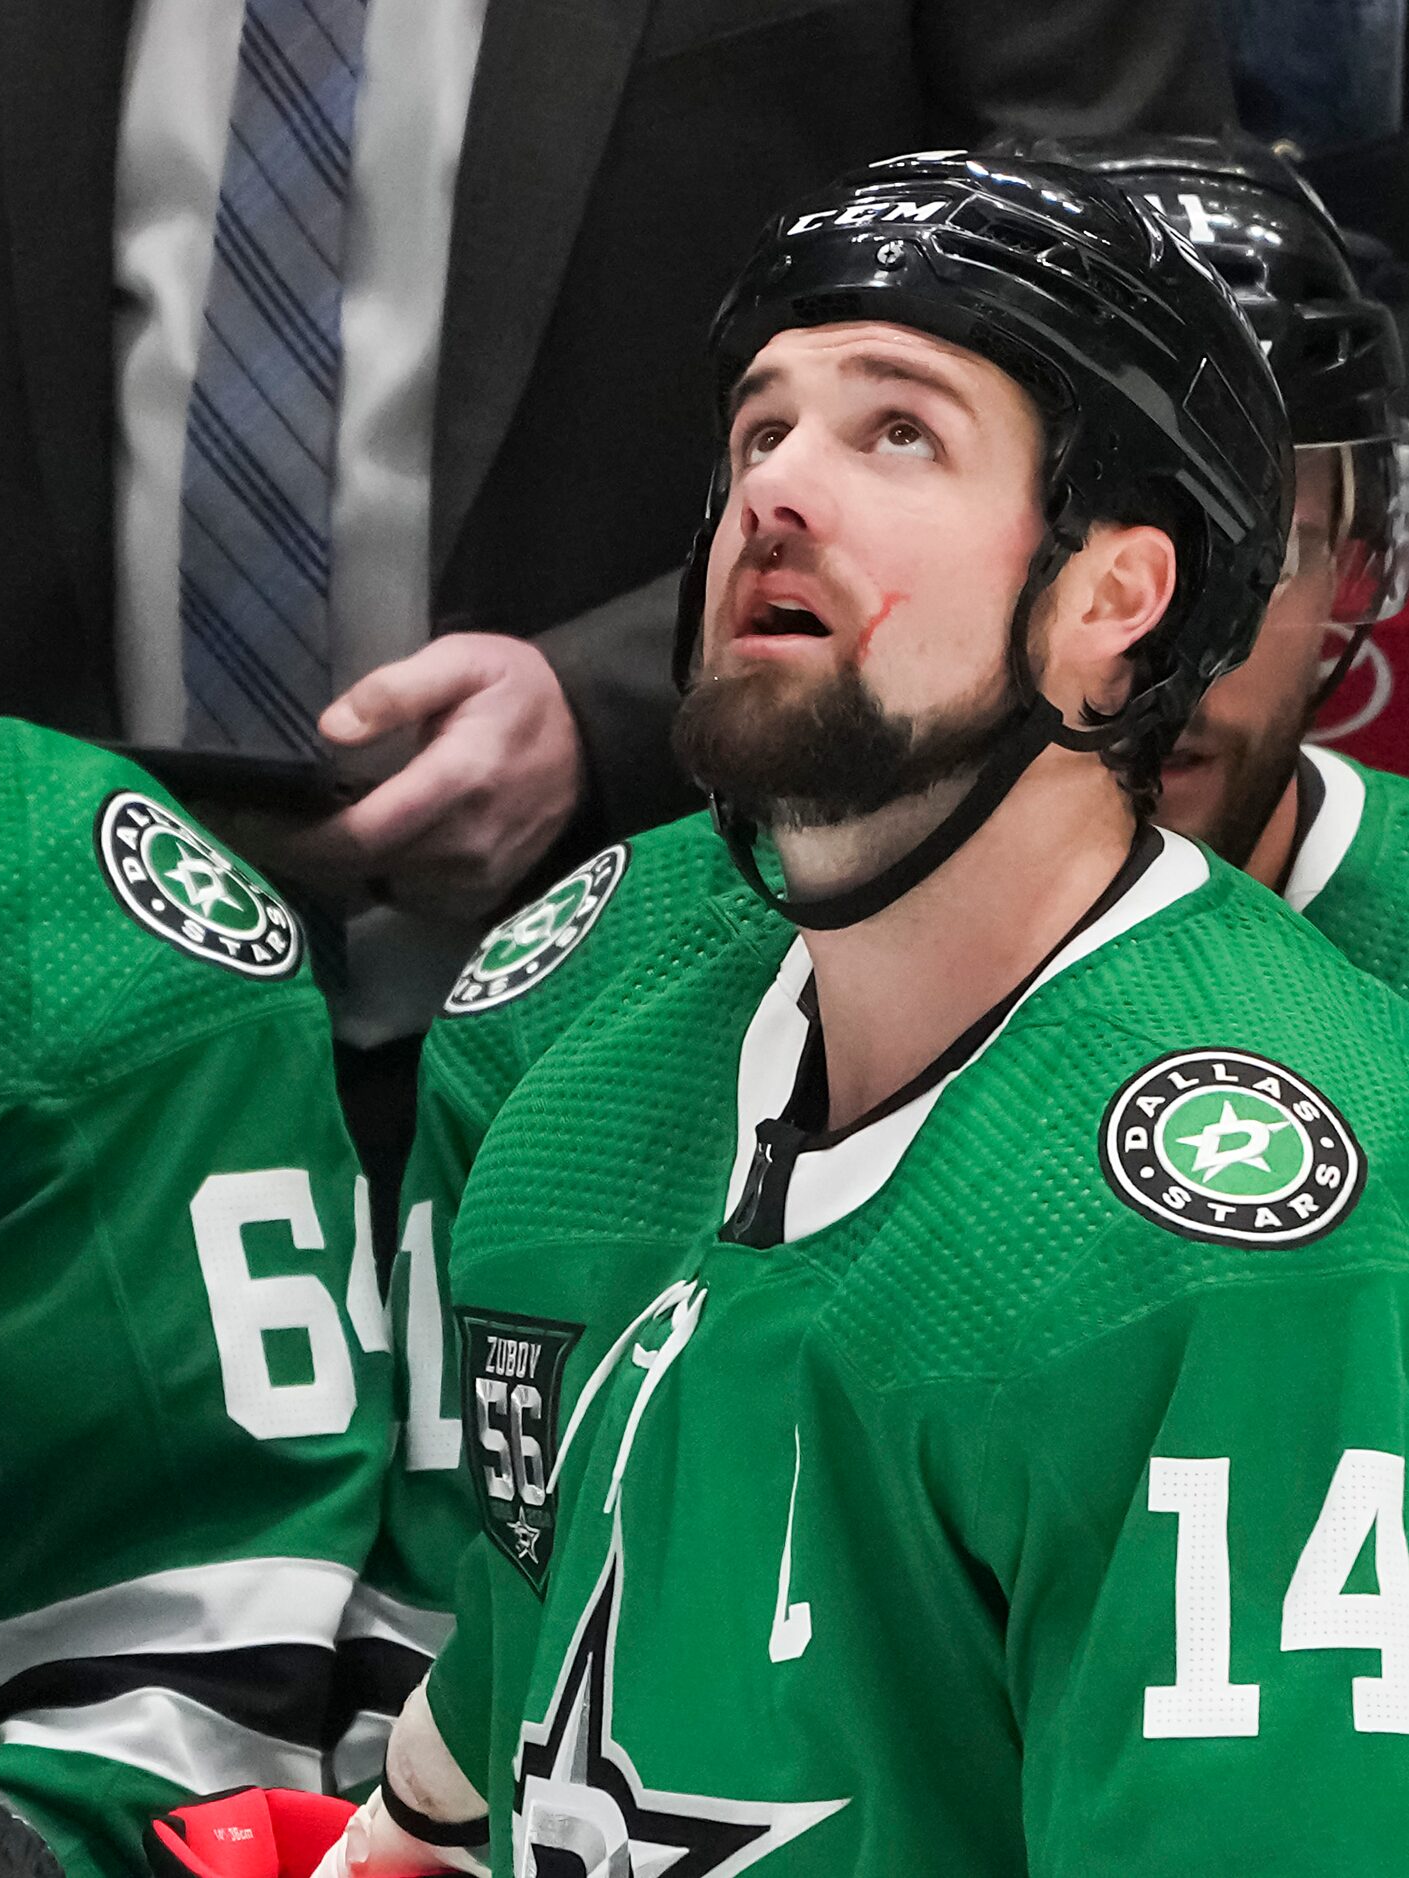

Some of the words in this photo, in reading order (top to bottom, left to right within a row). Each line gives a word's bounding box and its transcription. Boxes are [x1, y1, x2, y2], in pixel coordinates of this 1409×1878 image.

[786, 201, 947, 236] CCM
[181, 906, 288, 962] STARS
[1124, 1063, 1321, 1153] DALLAS
[1161, 1163, 1341, 1229] STARS
[485, 1336, 542, 1378] ZUBOV
[475, 1377, 546, 1506] 56
[1143, 1449, 1409, 1738] 14
